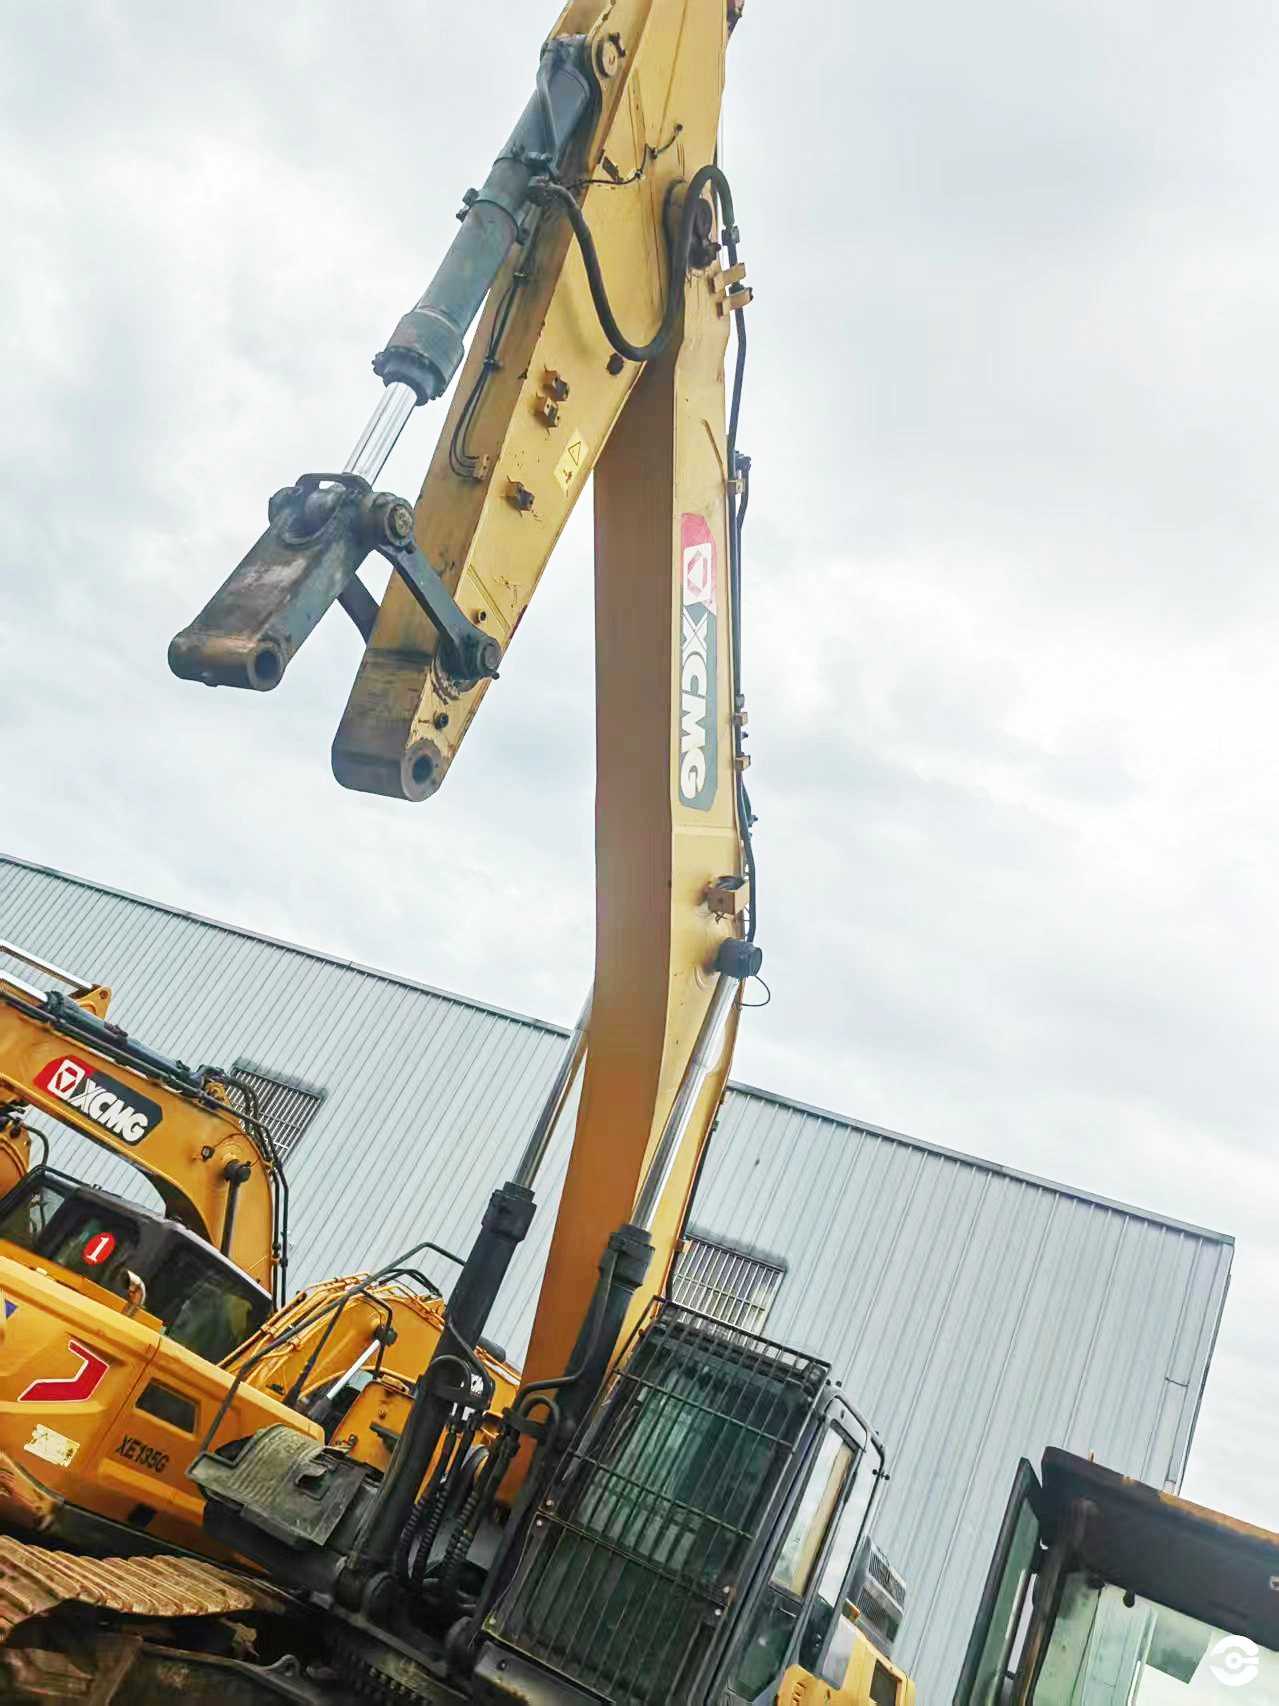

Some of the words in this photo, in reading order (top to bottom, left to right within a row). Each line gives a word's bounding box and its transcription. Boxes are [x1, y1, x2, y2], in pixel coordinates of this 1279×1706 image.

[680, 606, 708, 800] XCMG
[67, 1078, 148, 1142] XCMG
[86, 1237, 110, 1262] 1
